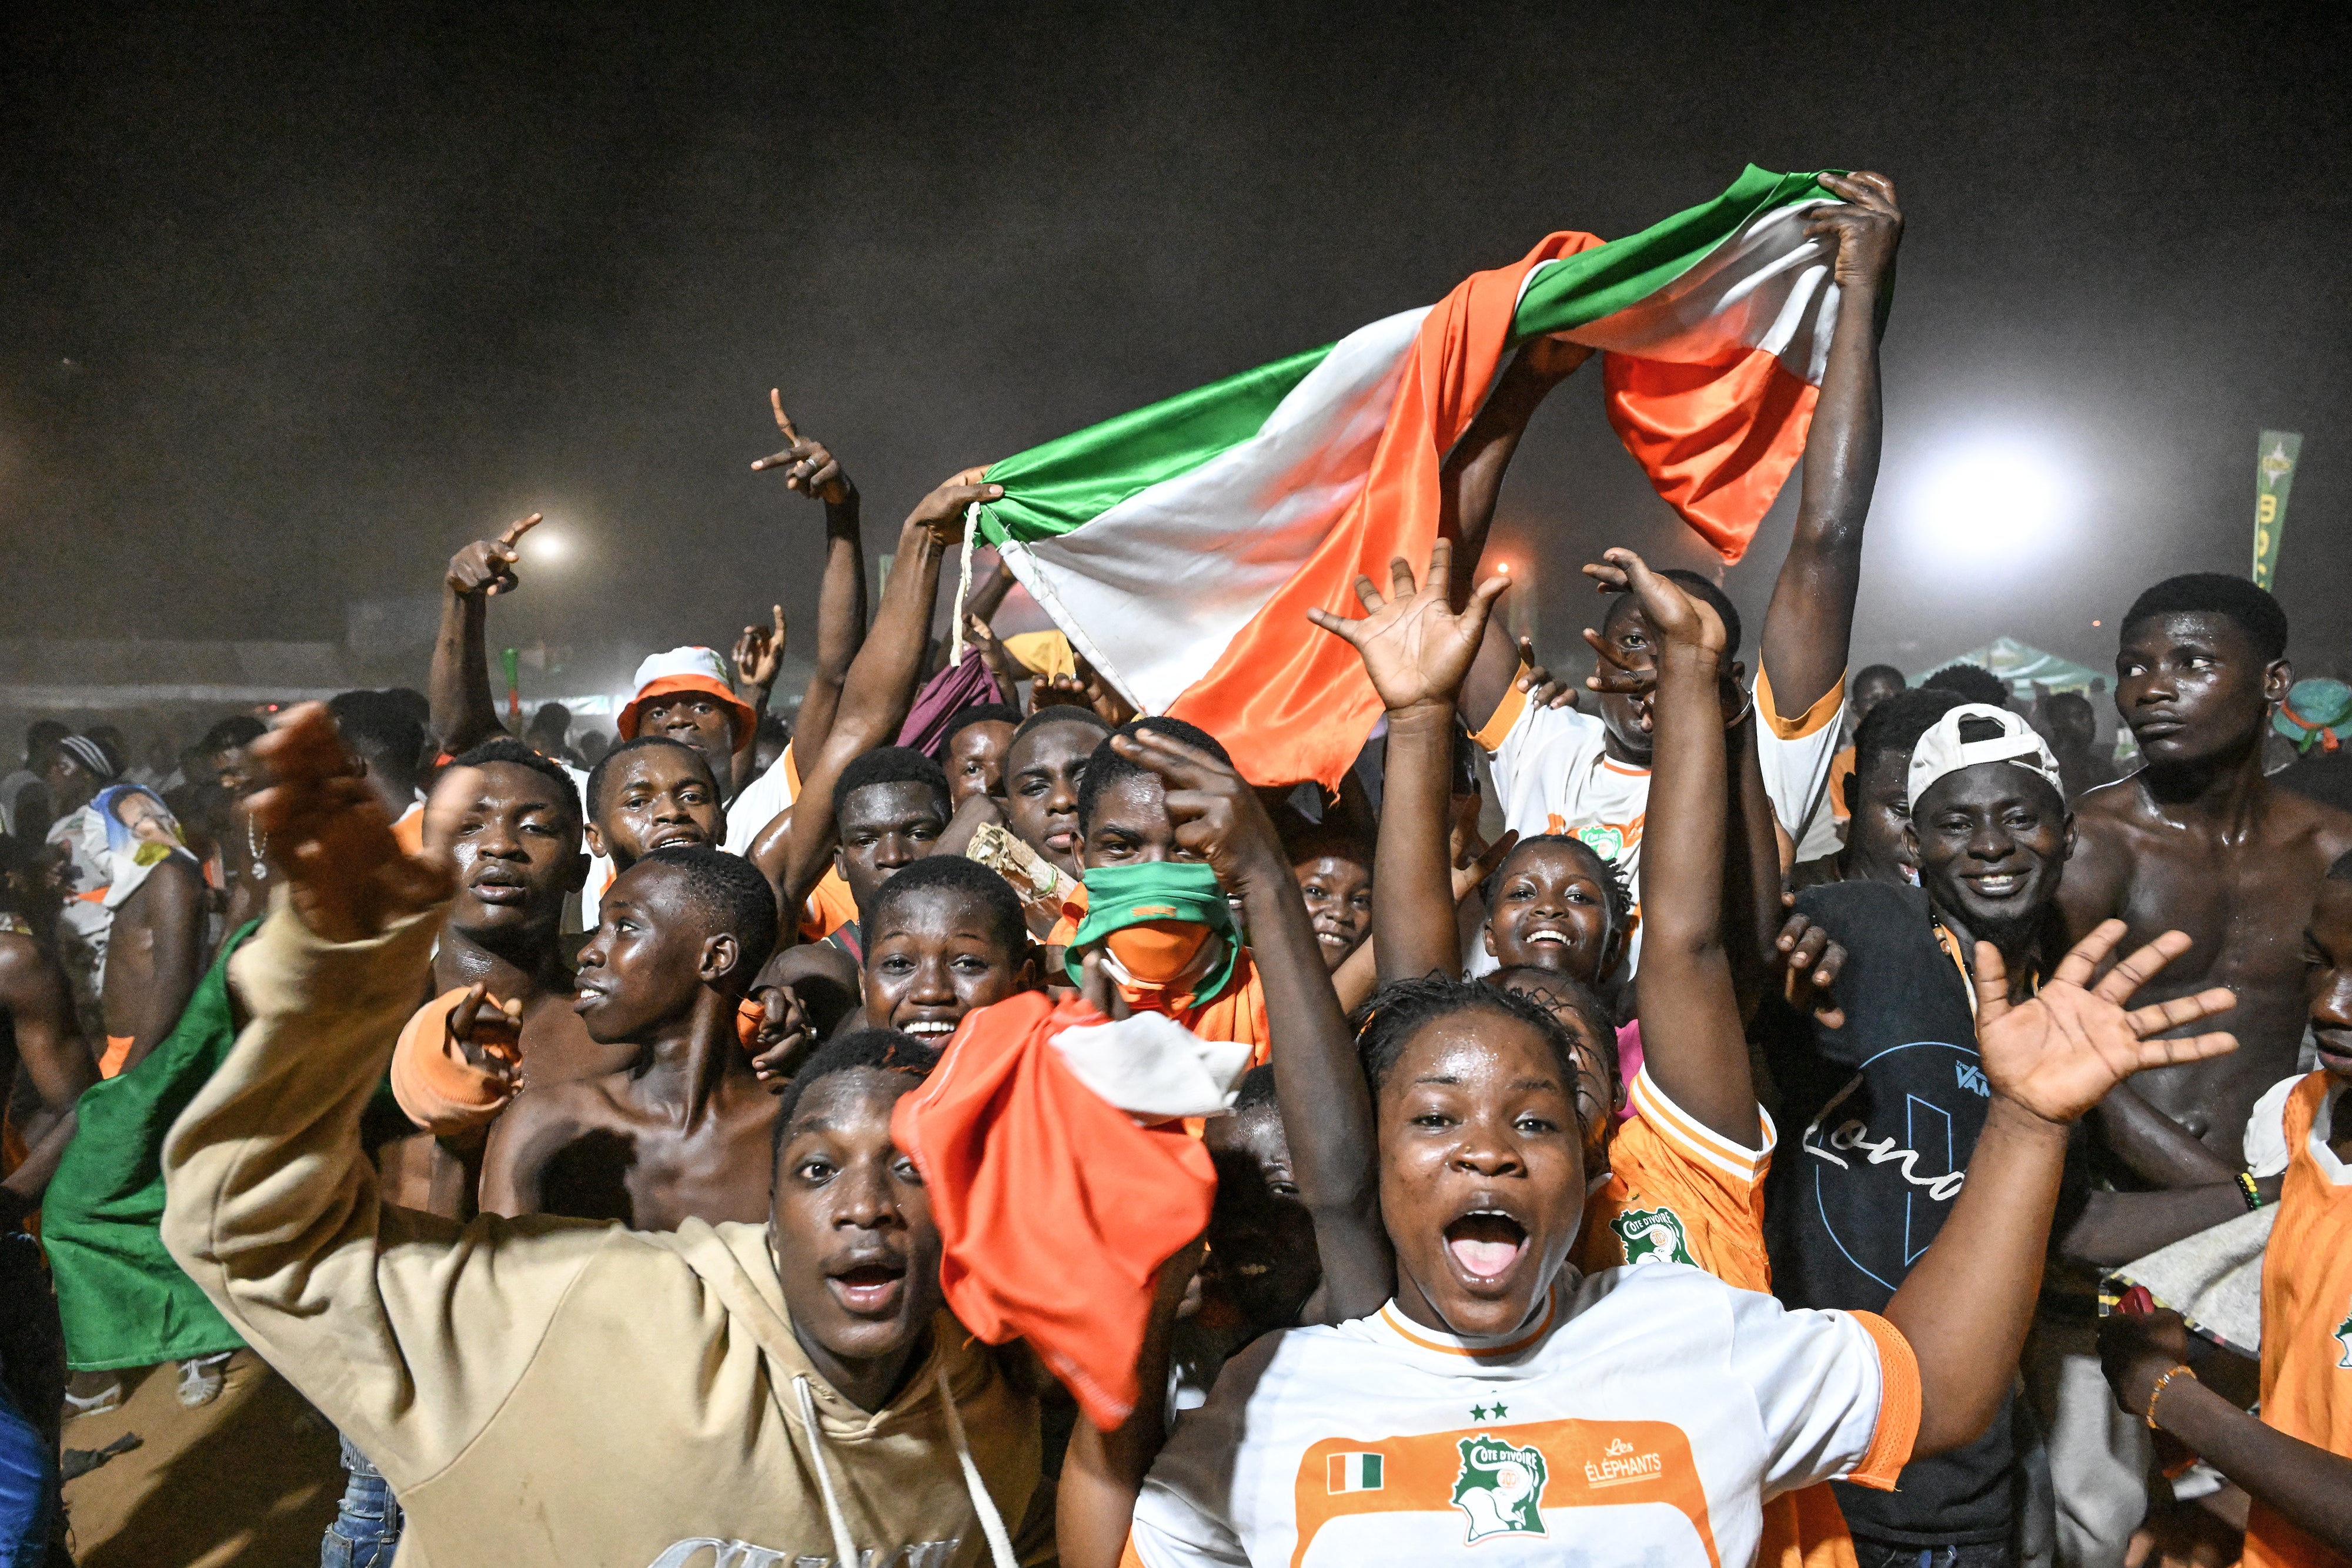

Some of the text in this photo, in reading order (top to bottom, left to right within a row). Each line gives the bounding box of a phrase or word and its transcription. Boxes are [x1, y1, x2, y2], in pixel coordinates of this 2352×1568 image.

[1642, 1212, 1673, 1226] D'IVOIRE
[1604, 1437, 1634, 1457] Les
[1499, 1449, 1538, 1470] D'IVOIRE
[1584, 1453, 1662, 1482] ÉLÉPHANTS
